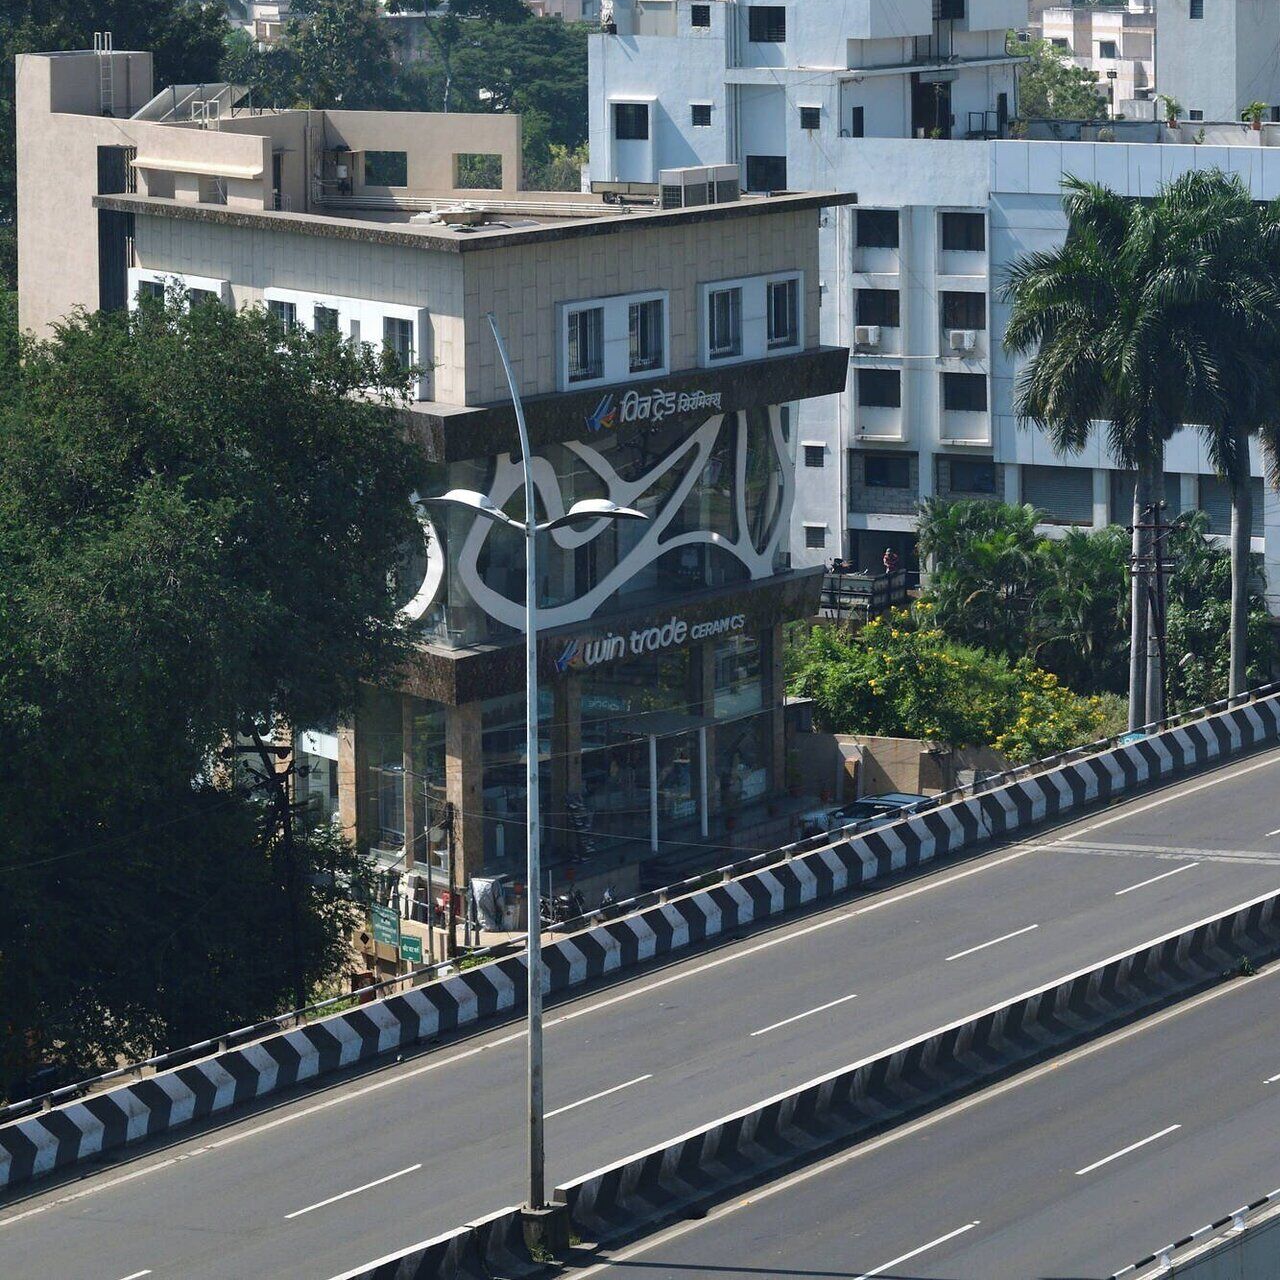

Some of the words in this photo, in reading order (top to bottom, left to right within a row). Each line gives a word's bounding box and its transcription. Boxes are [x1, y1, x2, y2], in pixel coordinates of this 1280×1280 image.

[620, 390, 651, 422] विन
[584, 632, 625, 666] win
[630, 616, 688, 655] trade
